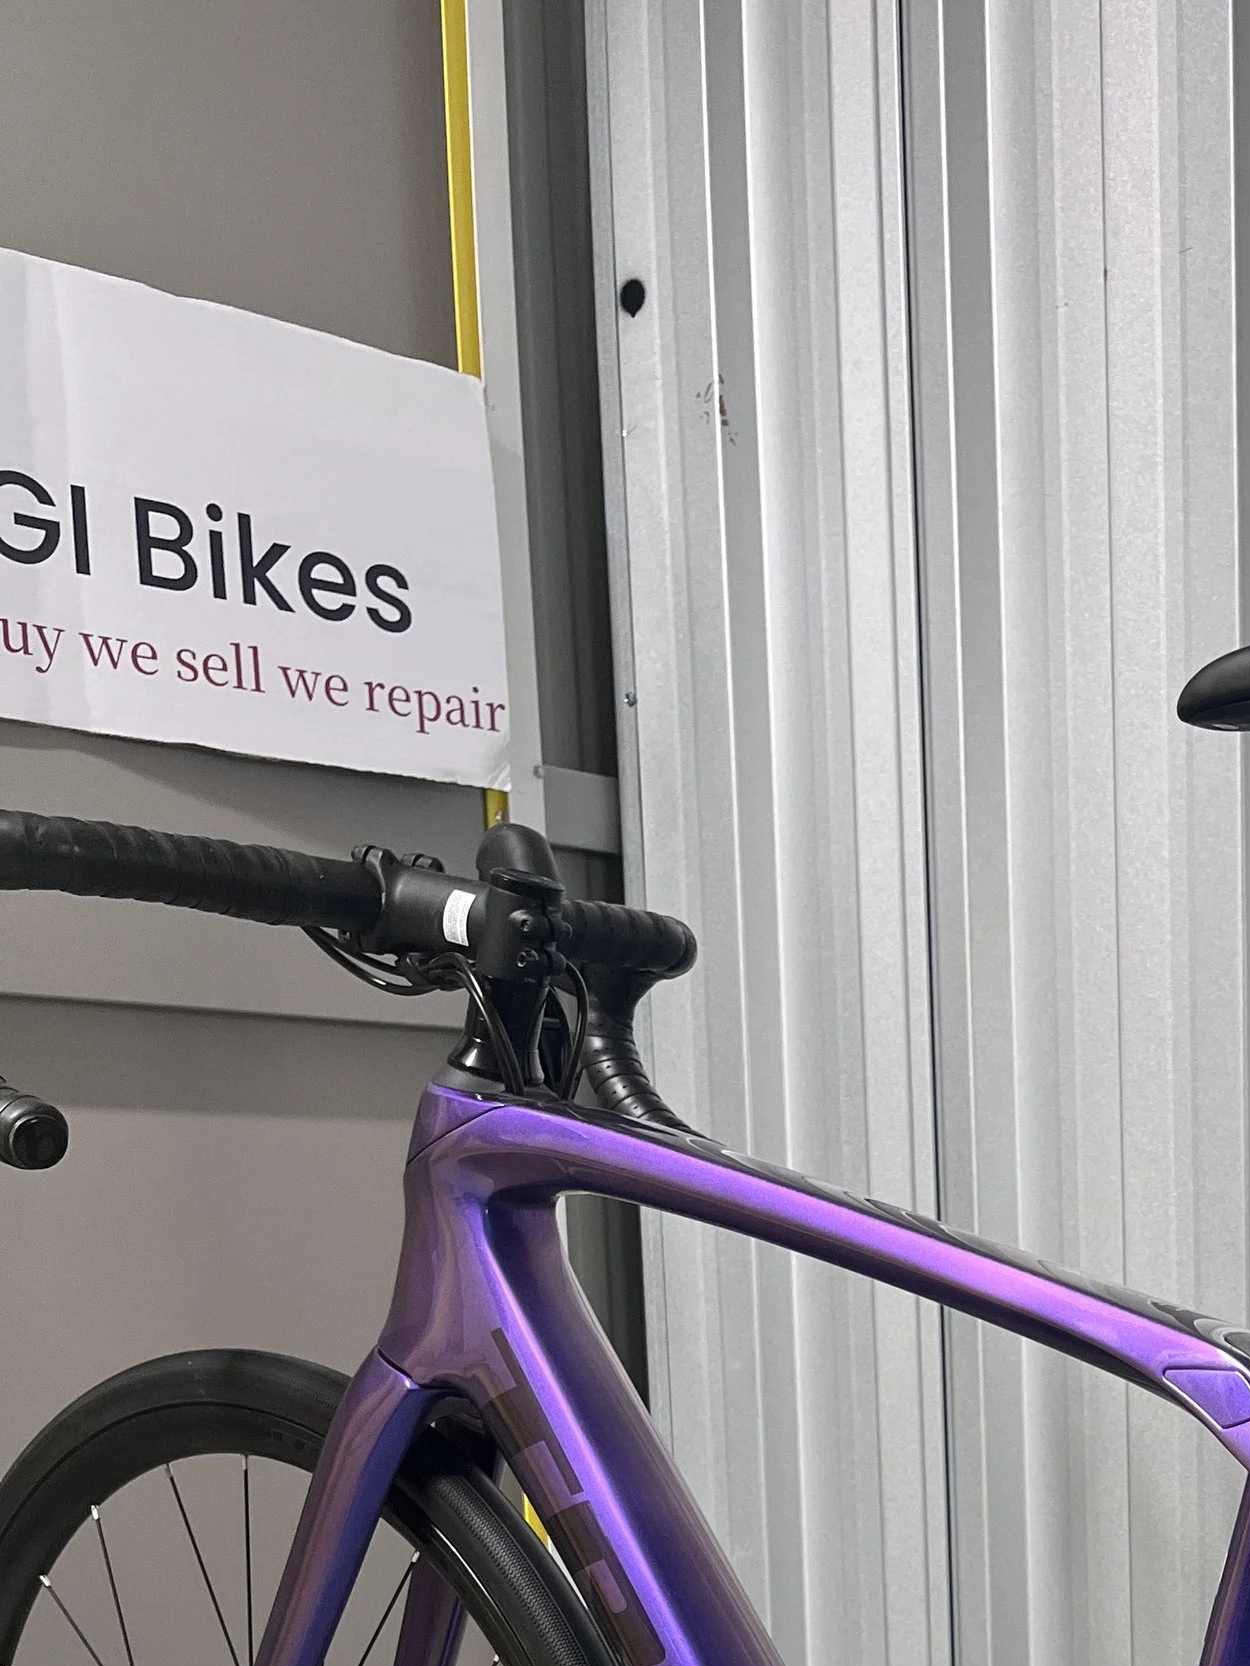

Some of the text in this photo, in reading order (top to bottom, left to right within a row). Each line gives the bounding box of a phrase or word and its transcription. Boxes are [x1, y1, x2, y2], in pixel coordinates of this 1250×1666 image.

[0, 470, 414, 634] GI Bikes
[79, 632, 158, 676] we
[177, 642, 266, 694] sell
[278, 665, 349, 707] we
[364, 681, 506, 735] repair
